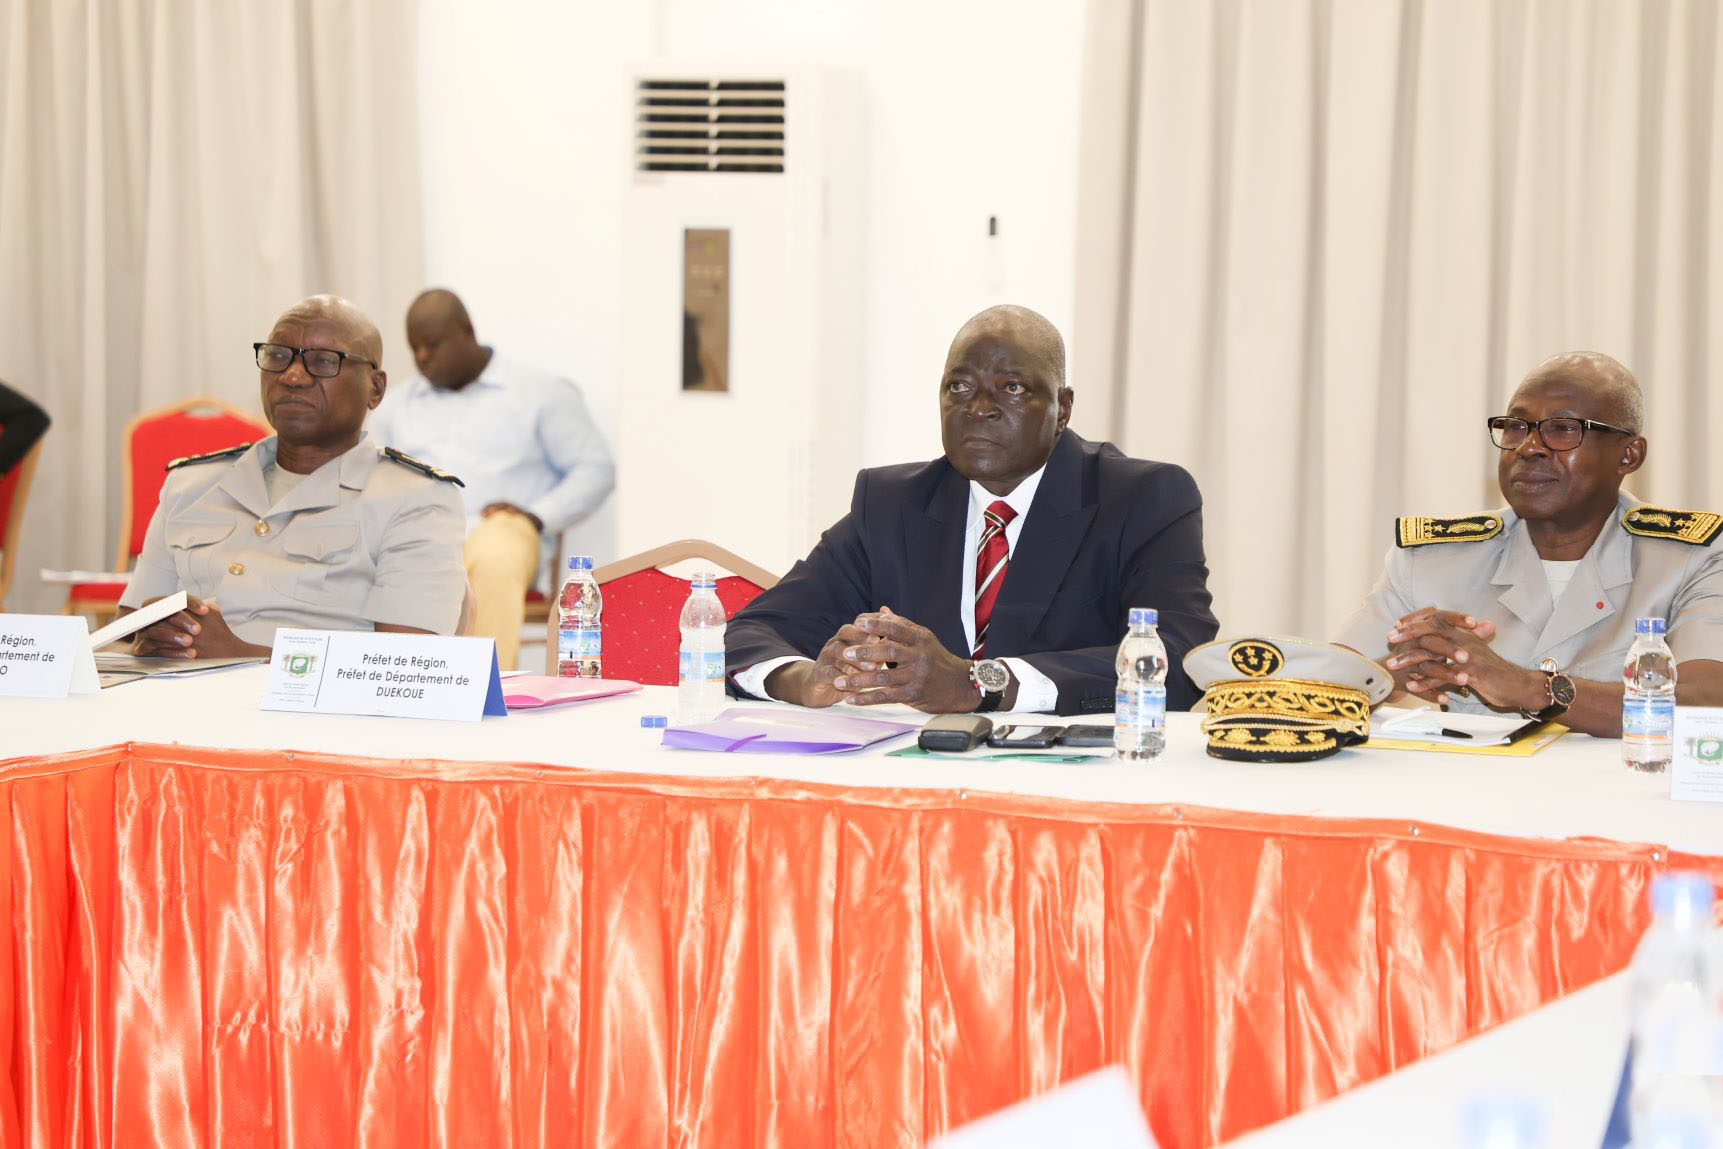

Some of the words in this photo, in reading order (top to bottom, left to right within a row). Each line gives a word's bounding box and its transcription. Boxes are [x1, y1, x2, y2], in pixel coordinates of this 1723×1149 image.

[0, 634, 36, 648] Région,
[42, 652, 55, 662] de
[362, 653, 391, 665] Préfet
[394, 656, 408, 666] de
[411, 656, 448, 670] Région,
[336, 667, 366, 680] Préfet
[368, 670, 382, 680] de
[385, 671, 453, 684] Département
[455, 675, 470, 686] de
[376, 686, 425, 699] DUEKOUE
